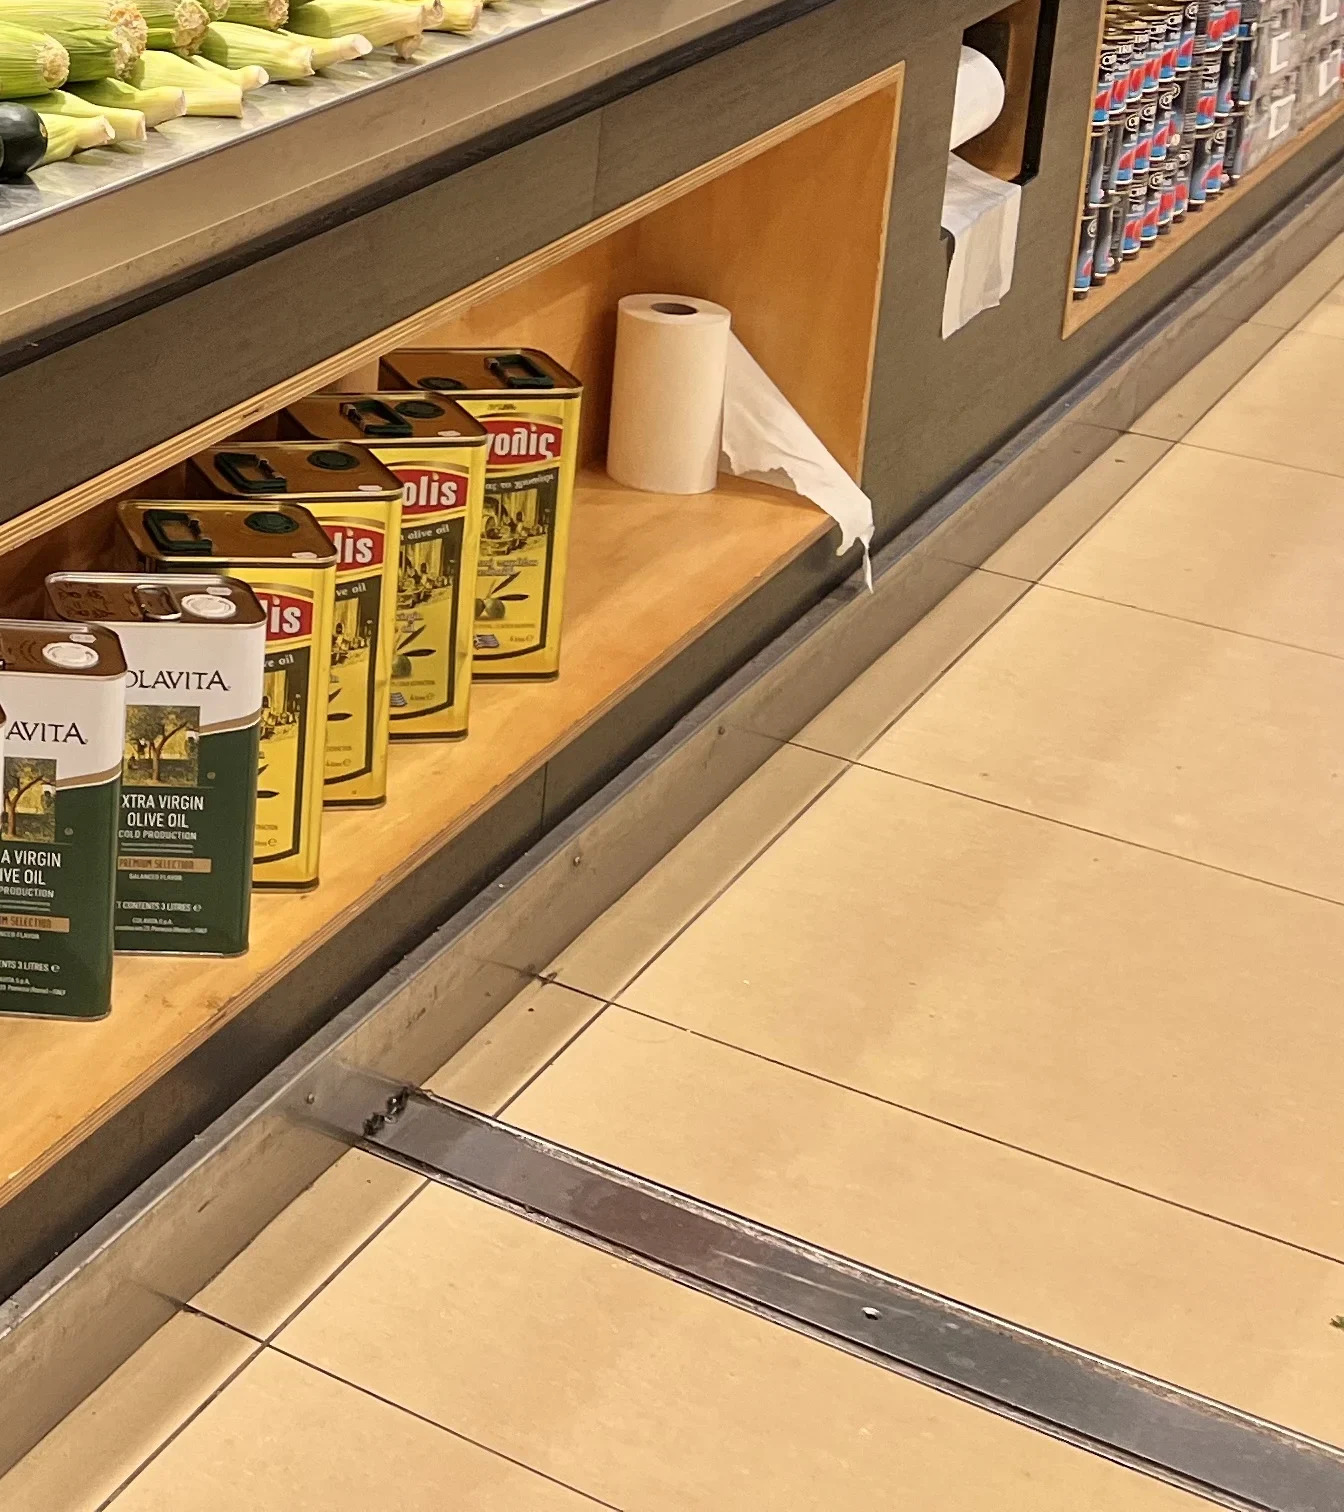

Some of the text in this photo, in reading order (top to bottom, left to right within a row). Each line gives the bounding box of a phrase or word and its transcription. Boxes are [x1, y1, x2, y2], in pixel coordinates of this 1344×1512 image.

[402, 473, 457, 506] olis
[408, 524, 450, 539] olive oil
[352, 583, 366, 594] oil
[279, 654, 294, 666] oil
[6, 721, 86, 745] AVITA
[122, 795, 204, 810] XTRA VIRGIN
[128, 812, 189, 828] OLIVE OIL
[118, 830, 197, 840] COLD PRODUCTION
[14, 850, 61, 867] VIRGIN
[24, 869, 46, 885] OIL
[0, 886, 54, 898] PRODUCTION
